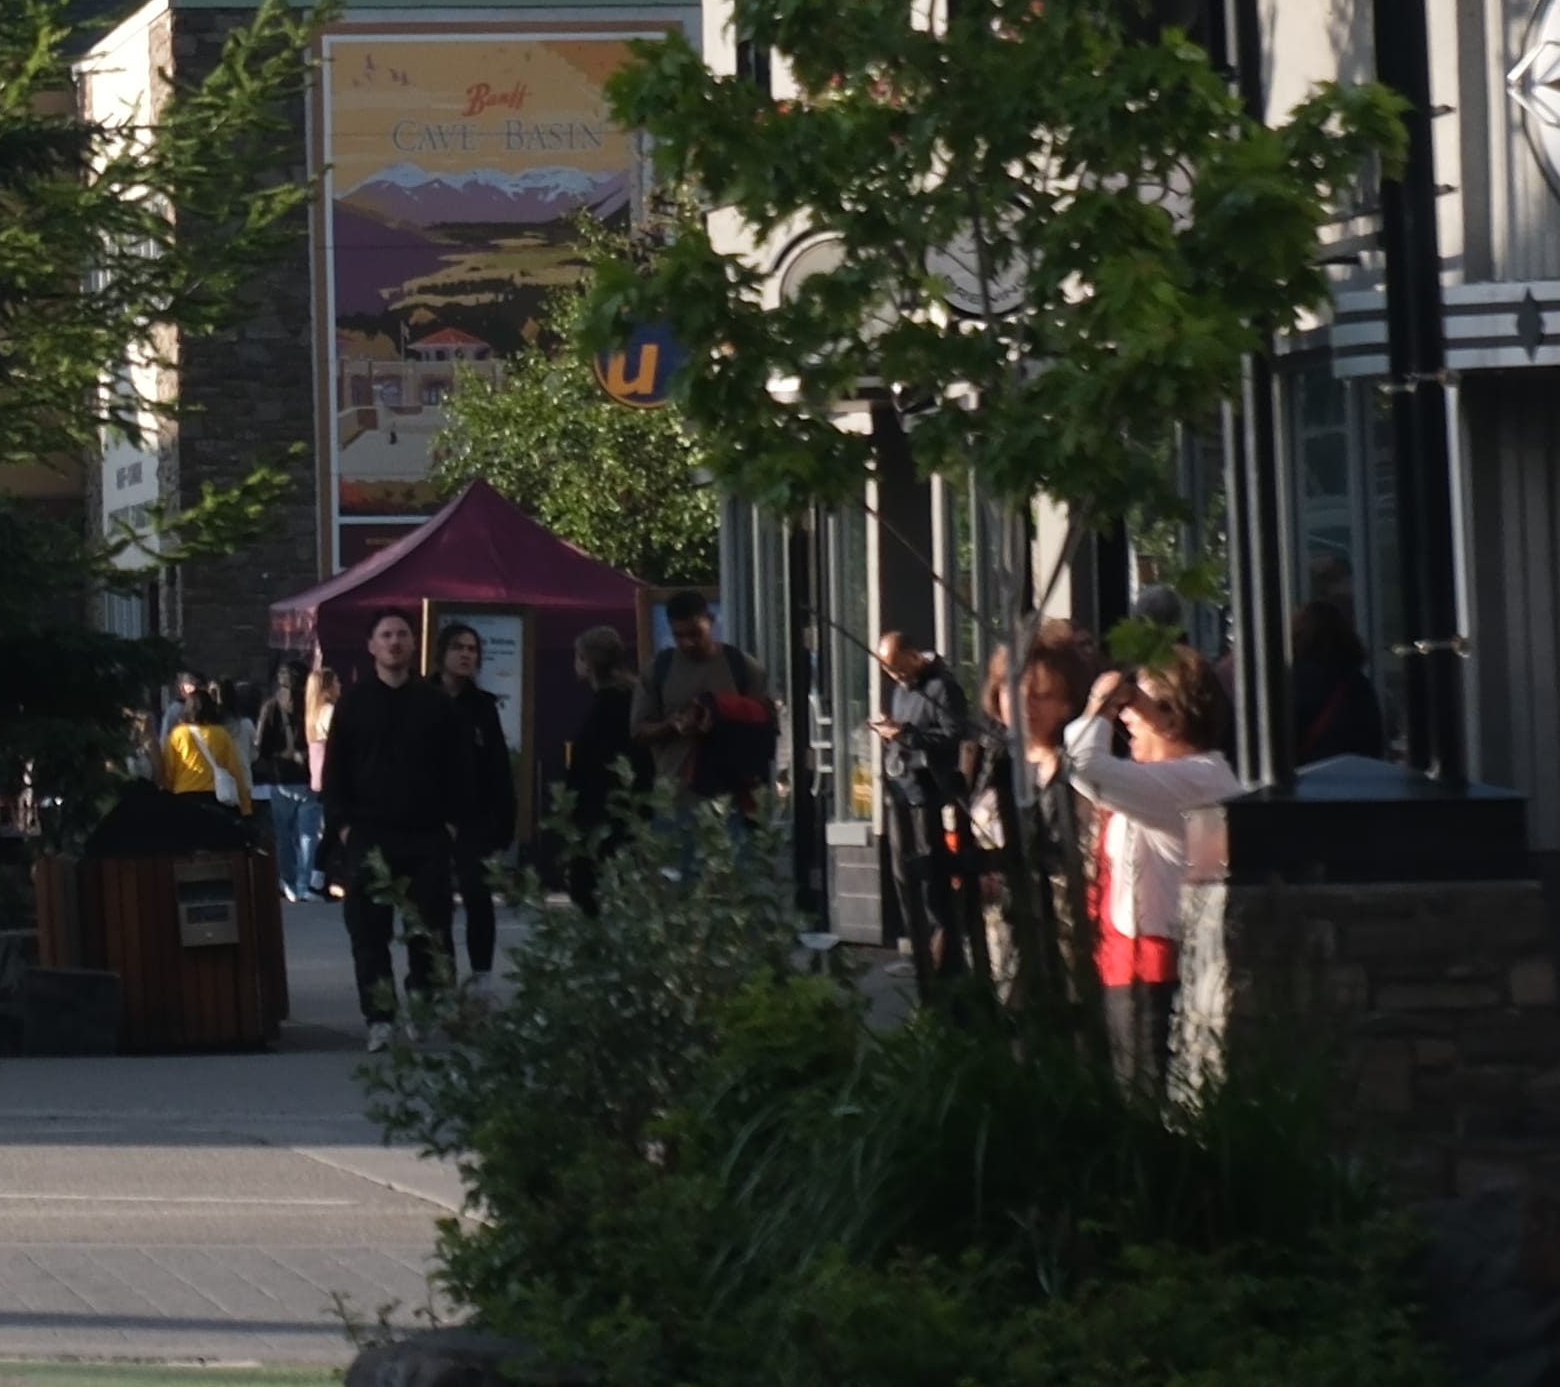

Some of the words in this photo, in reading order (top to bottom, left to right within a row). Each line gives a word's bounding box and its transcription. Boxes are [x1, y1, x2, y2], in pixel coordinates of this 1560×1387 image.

[462, 82, 532, 117] Banff
[392, 119, 478, 151] CAVE
[505, 118, 604, 151] BASIN
